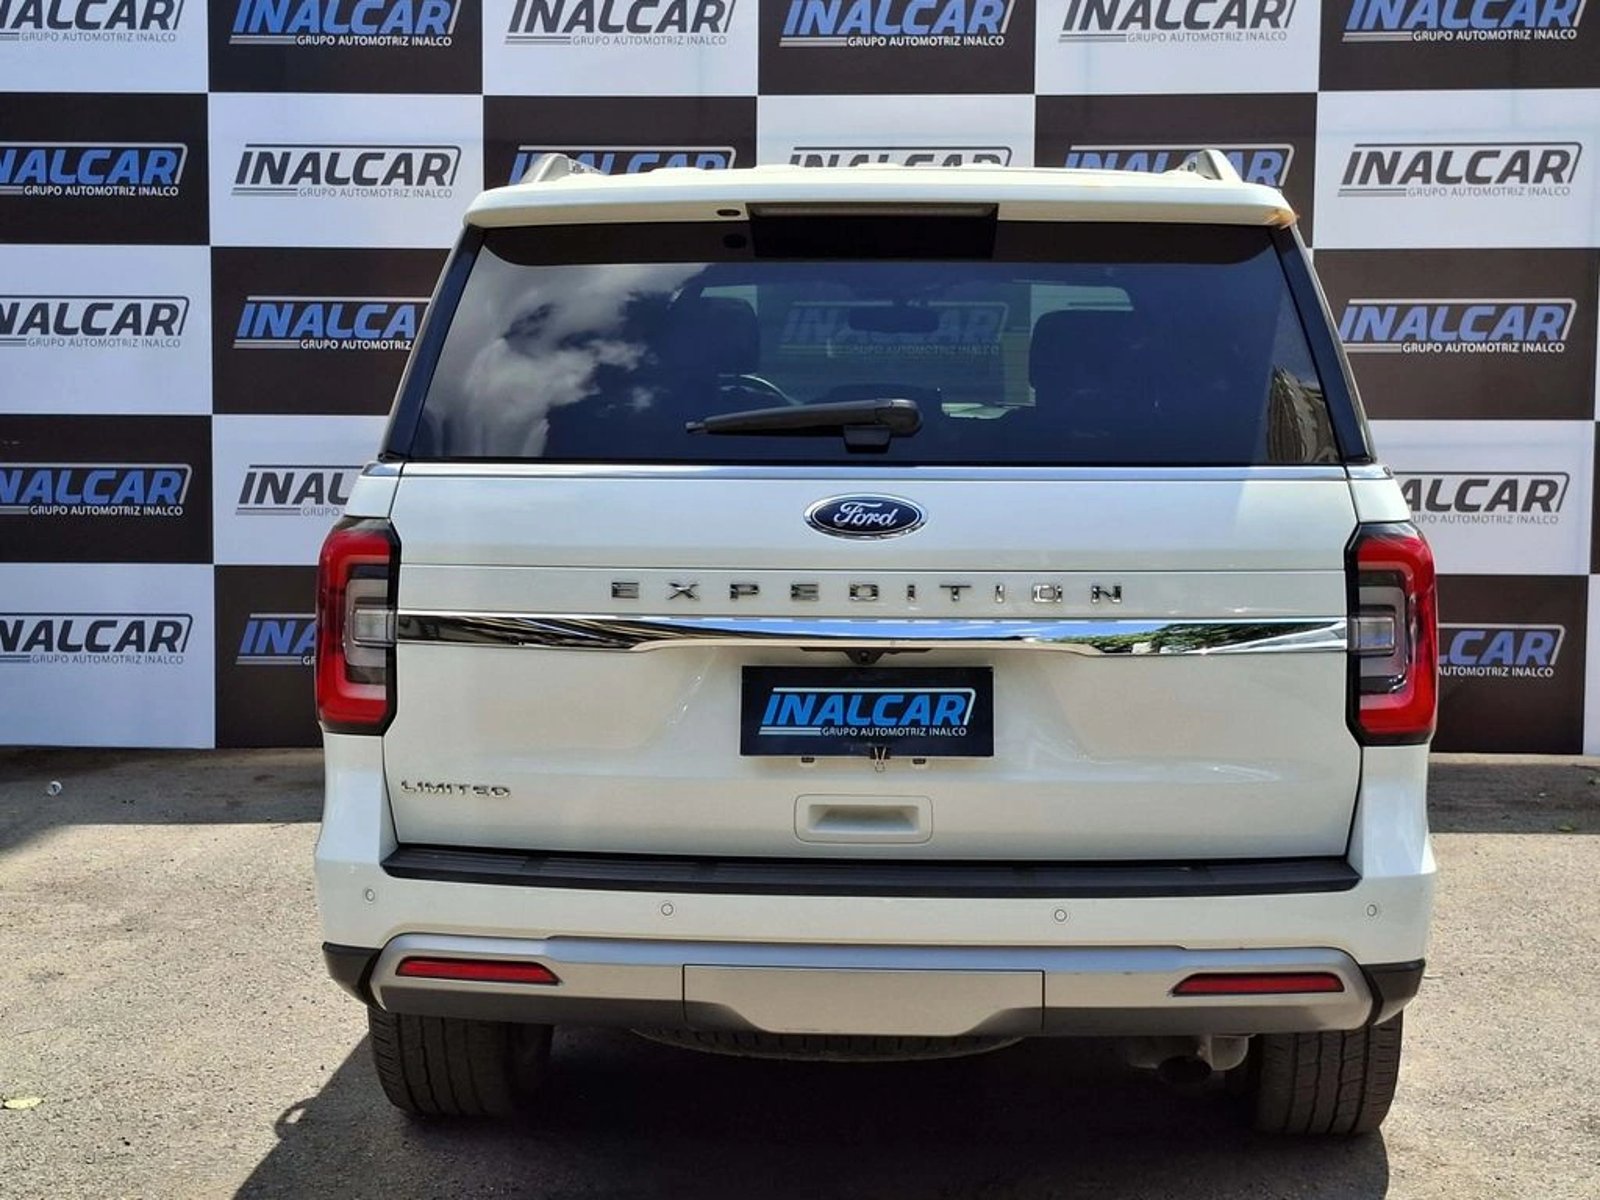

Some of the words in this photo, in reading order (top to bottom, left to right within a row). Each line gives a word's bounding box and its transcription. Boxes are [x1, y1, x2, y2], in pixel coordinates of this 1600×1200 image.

[0, 0, 174, 30] ALCAR
[232, 0, 450, 34] INALCAR
[508, 0, 726, 33] INALCAR
[783, 0, 1005, 35] INALCAR
[1062, 0, 1288, 31] INALCAR
[1346, 0, 1575, 29] INALCAR
[21, 32, 59, 42] GRUPO
[62, 32, 134, 42] AUTOMOTRIZ
[137, 33, 177, 43] INALCO
[297, 35, 336, 46] GRUPO
[338, 35, 409, 46] AUTOMOTRIZ
[412, 36, 452, 46] INALCO
[573, 36, 610, 46] GRUPO
[613, 36, 684, 46] AUTOMOTRIZ
[687, 36, 727, 46] INALCO
[848, 36, 887, 46] GRUPO
[889, 36, 961, 46] AUTOMOTRIZ
[963, 36, 1005, 46] INALCO
[1128, 32, 1167, 43] GRUPO
[1170, 32, 1242, 42] AUTOMOTRIZ
[1246, 31, 1288, 42] INALCO
[1413, 30, 1454, 42] GRUPO
[1456, 30, 1531, 41] AUTOMOTRIZ
[1534, 29, 1577, 40] INALCO
[235, 151, 452, 186] INALCAR
[1341, 150, 1571, 185] INALCAR
[24, 185, 62, 196] GRUPO
[65, 185, 136, 196] AUTOMOTRIZ
[139, 186, 179, 196] INALCO
[299, 188, 337, 198] GRUPO
[340, 188, 410, 198] AUTOMOTRIZ
[413, 189, 453, 199] INALCO
[1408, 187, 1448, 198] GRUPO
[1451, 186, 1525, 197] AUTOMOTRIZ
[1528, 186, 1571, 197] INALCO
[236, 303, 416, 338] INALCA
[1338, 305, 1566, 341] INALCAR
[28, 338, 66, 348] GRUPO
[69, 338, 138, 348] AUTOMOTRIZ
[142, 338, 181, 348] INALCO
[301, 339, 339, 350] GRUPO
[341, 339, 413, 350] AUTOMOTRIZ
[1402, 342, 1443, 353] GRUPO
[1445, 342, 1520, 353] AUTOMOTRIZ
[1522, 342, 1565, 353] INALCO
[238, 472, 350, 505] INAL
[1401, 478, 1559, 513] ALCAR
[30, 505, 68, 516] GRUPO
[71, 505, 141, 516] AUTOMOTRIZ
[143, 506, 184, 516] INALCO
[302, 507, 340, 517] GRUPO
[834, 501, 899, 527] Ford
[1440, 514, 1514, 525] AUTOMOTRIZ
[1516, 515, 1559, 525] INALCO
[610, 581, 1124, 603] EXPEDITION
[32, 654, 69, 665] GRUPO
[72, 654, 142, 665] AUTOMOTRIZ
[145, 655, 184, 665] INALCO
[1511, 667, 1554, 678] INALCO
[762, 694, 967, 726] INALCAR
[822, 727, 859, 737] GRUPO
[860, 727, 927, 737] AUTOMOTRIZ
[929, 727, 967, 737] INALCO
[400, 779, 512, 798] LIMITED
